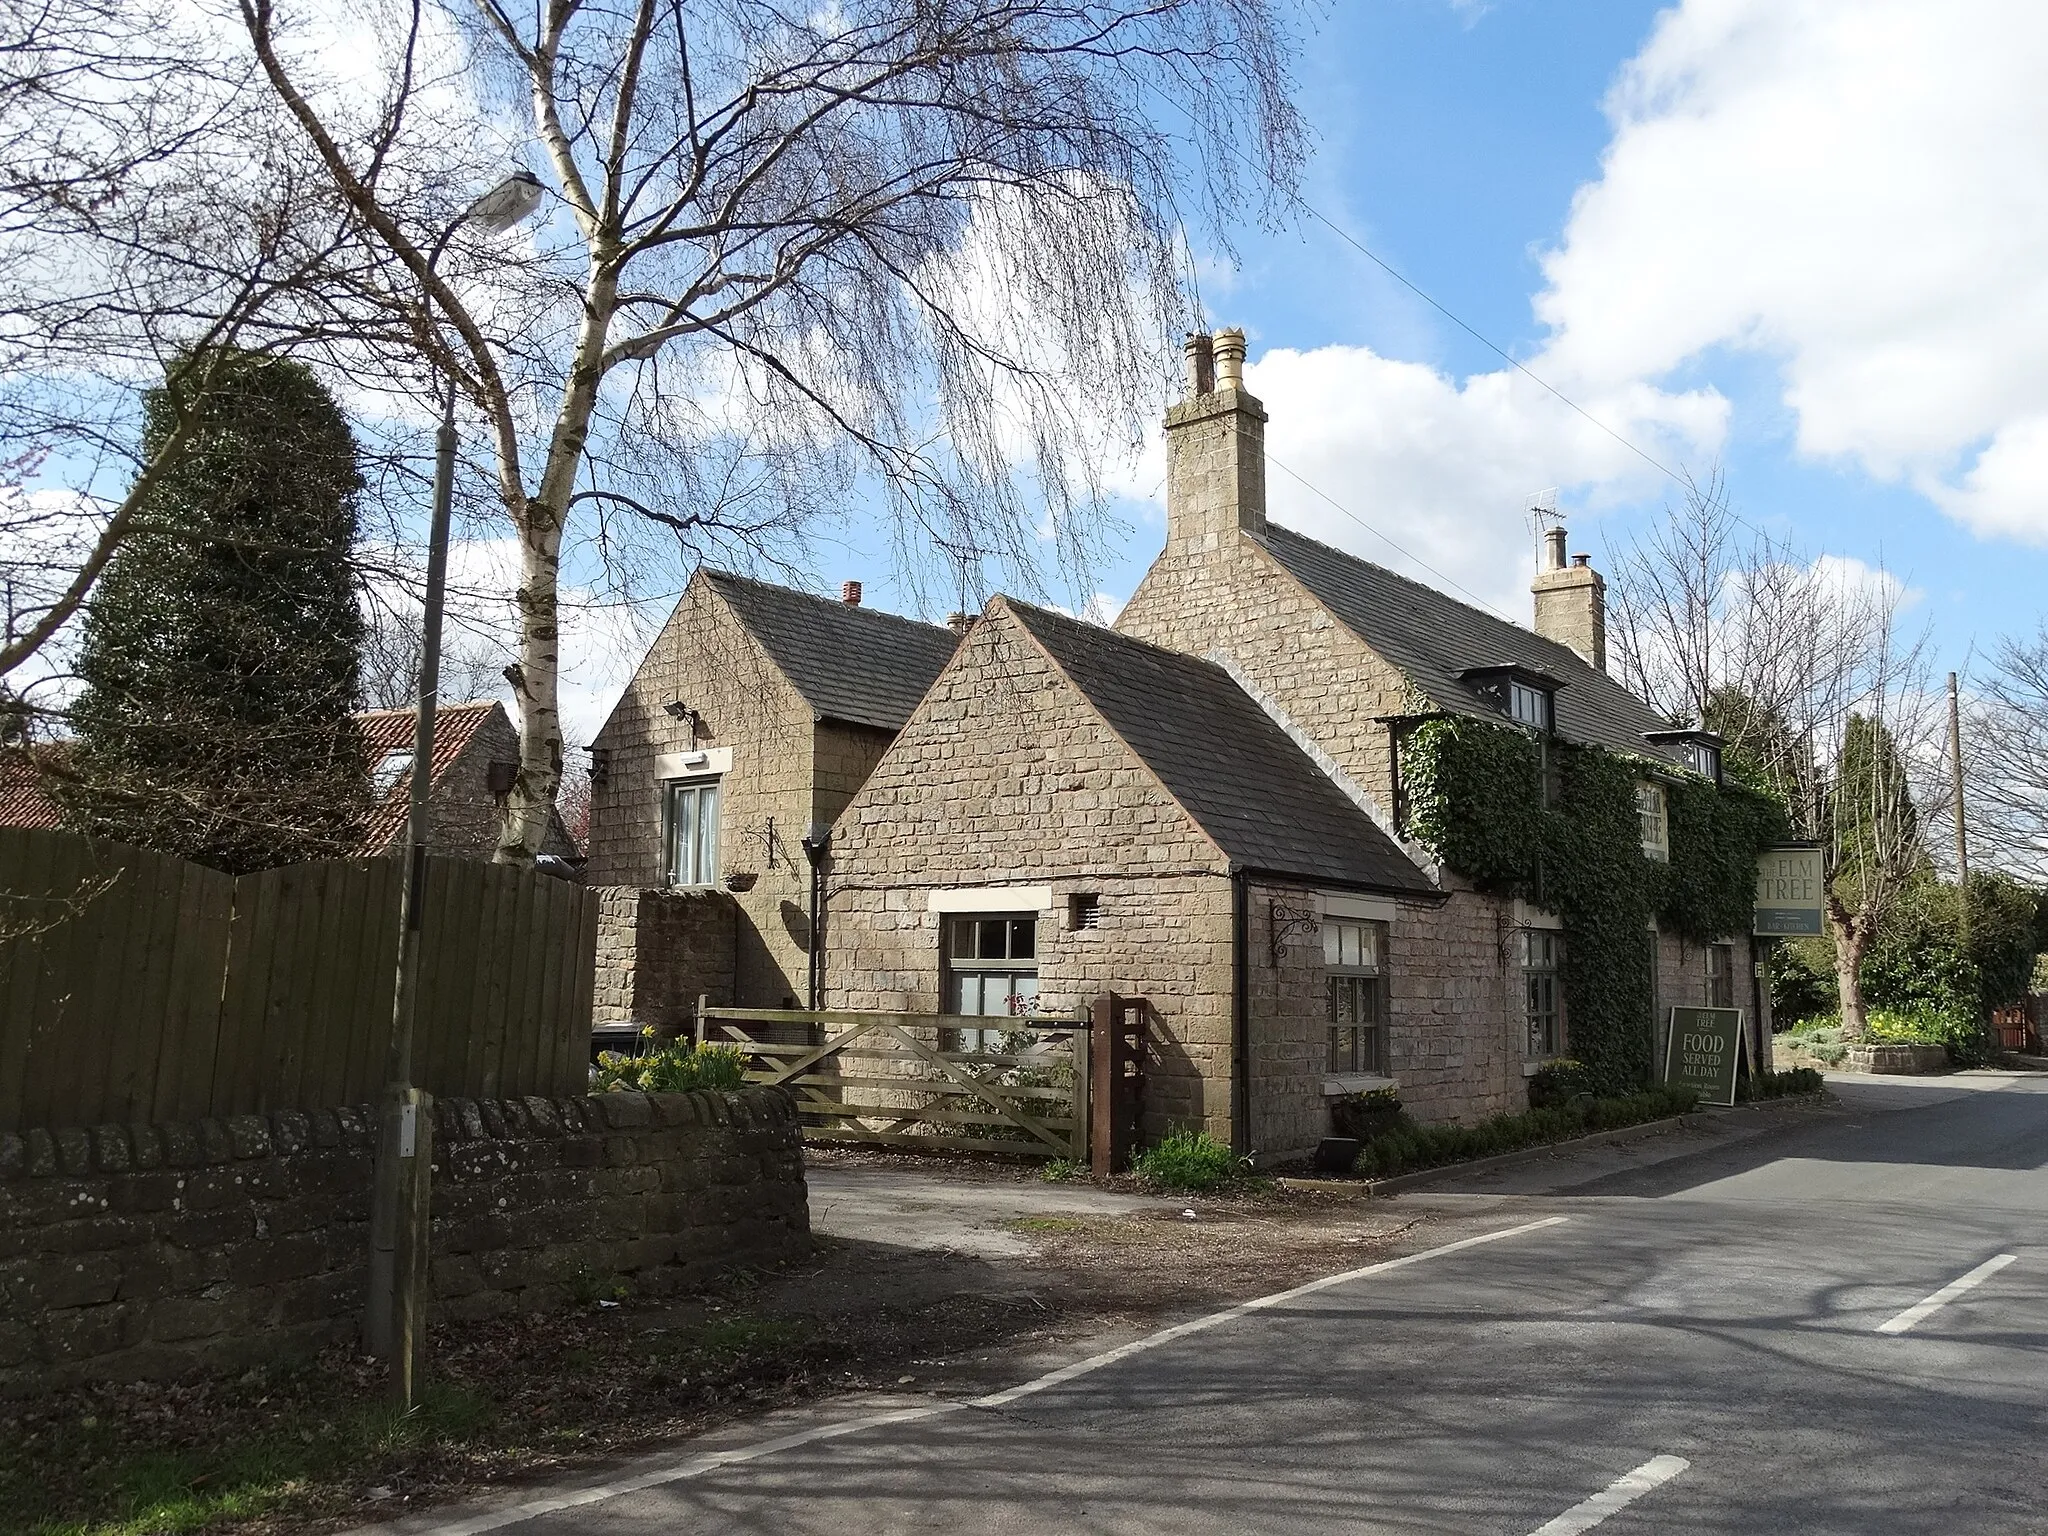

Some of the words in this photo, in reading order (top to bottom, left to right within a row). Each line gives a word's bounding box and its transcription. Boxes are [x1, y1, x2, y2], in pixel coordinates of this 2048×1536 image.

[1778, 860, 1812, 877] ELM
[1761, 879, 1813, 900] TREE
[1683, 1033, 1724, 1053] FOOD
[1683, 1053, 1721, 1065] SERVED
[1681, 1065, 1699, 1077] ALL
[1700, 1066, 1720, 1078] DAY
